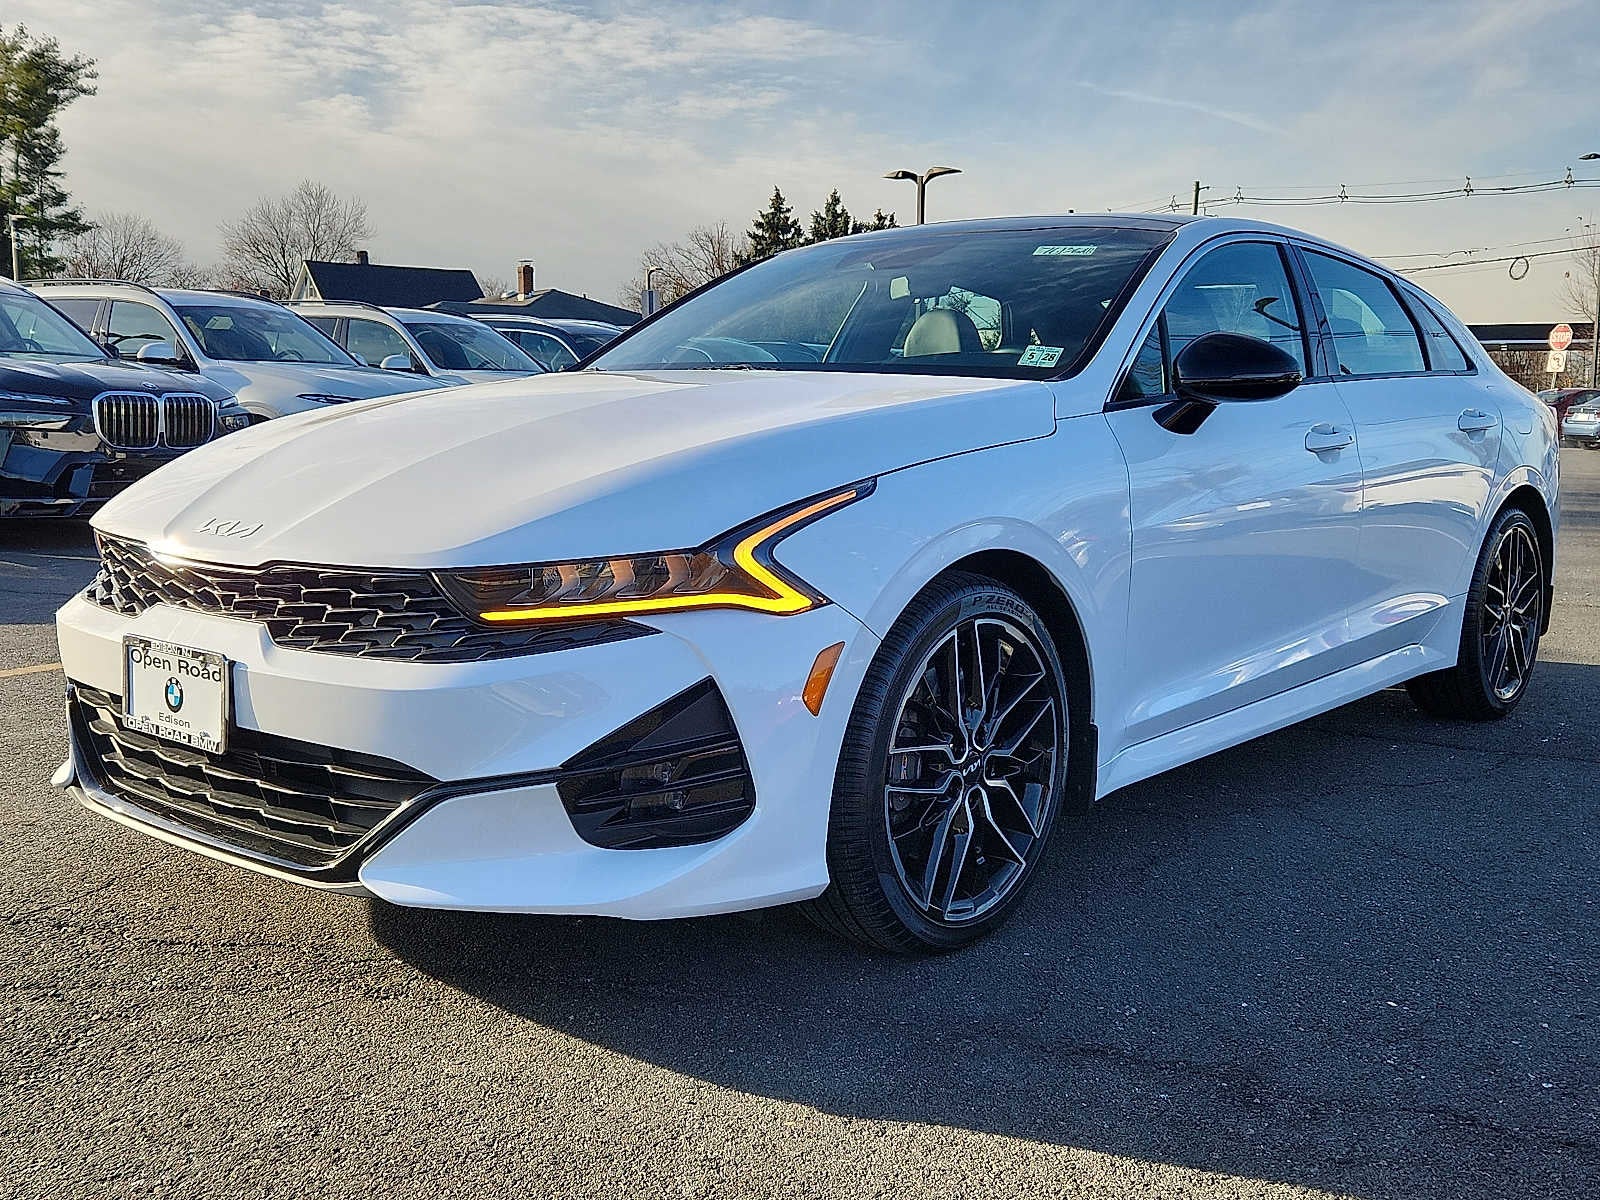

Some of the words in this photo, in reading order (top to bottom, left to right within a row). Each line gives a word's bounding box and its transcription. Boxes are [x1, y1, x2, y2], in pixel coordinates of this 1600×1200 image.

[1552, 332, 1571, 342] STOP
[1027, 352, 1036, 360] 5
[1041, 353, 1056, 361] 28
[973, 595, 982, 606] P
[985, 595, 1025, 614] ZERO
[130, 648, 172, 671] Open
[177, 659, 222, 682] Road
[159, 712, 190, 729] Edison
[127, 717, 156, 734] OPEN
[158, 726, 189, 742] ROAD
[191, 735, 218, 752] BMW
